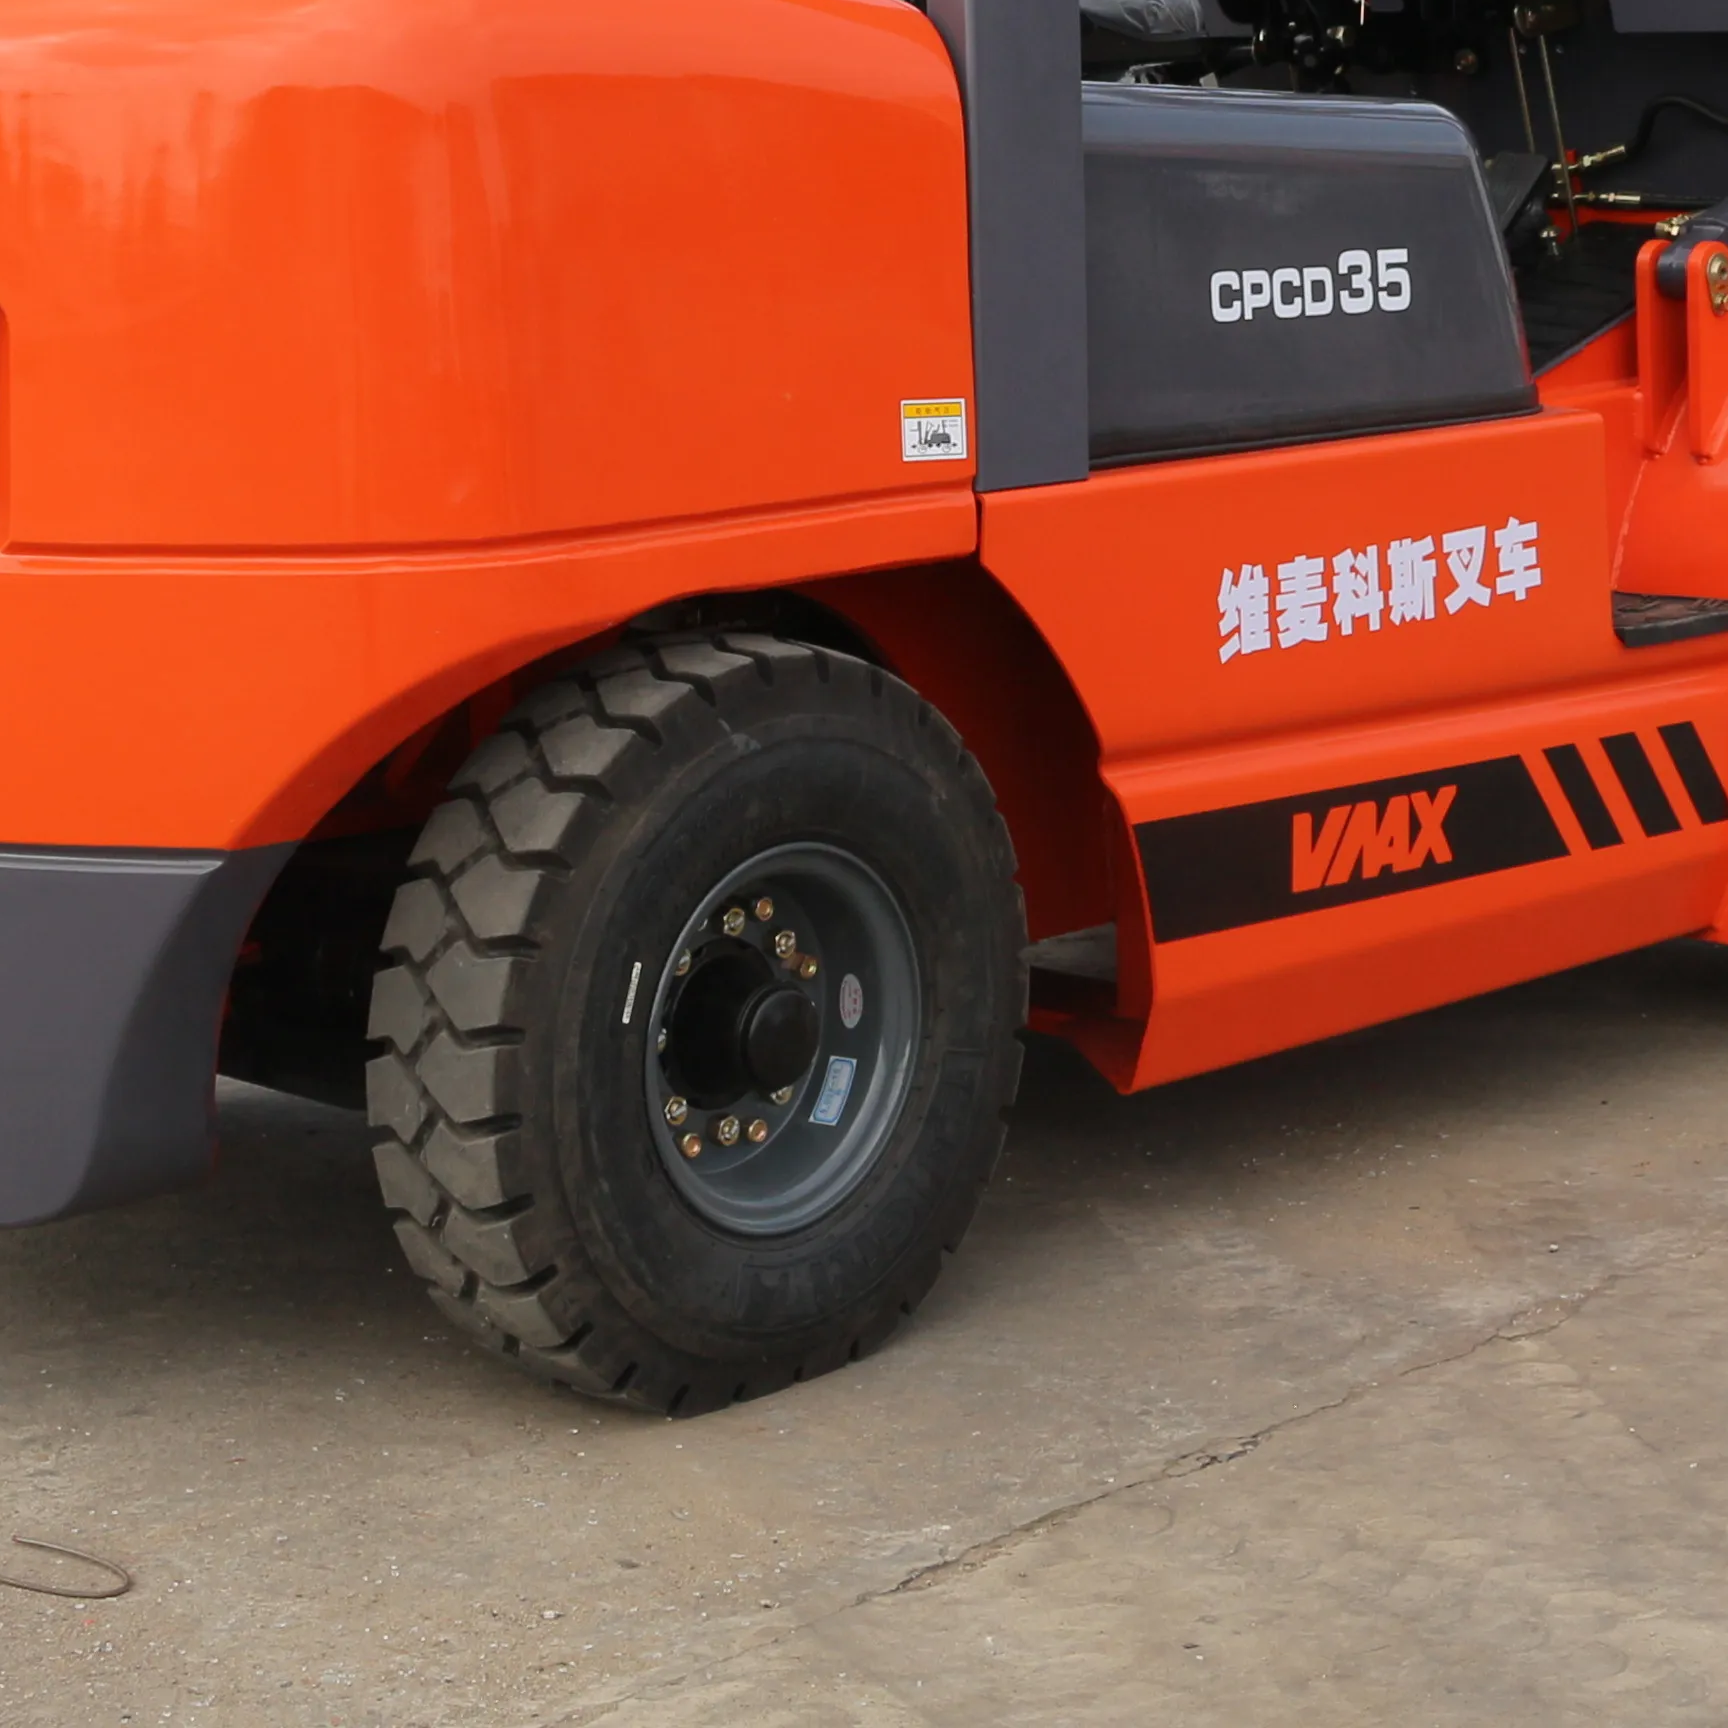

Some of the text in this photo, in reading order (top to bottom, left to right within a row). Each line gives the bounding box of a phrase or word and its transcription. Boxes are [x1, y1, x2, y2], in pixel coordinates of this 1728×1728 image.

[1218, 516, 1542, 665] 维麦科斯叉车
[1291, 784, 1458, 894] VMAX
